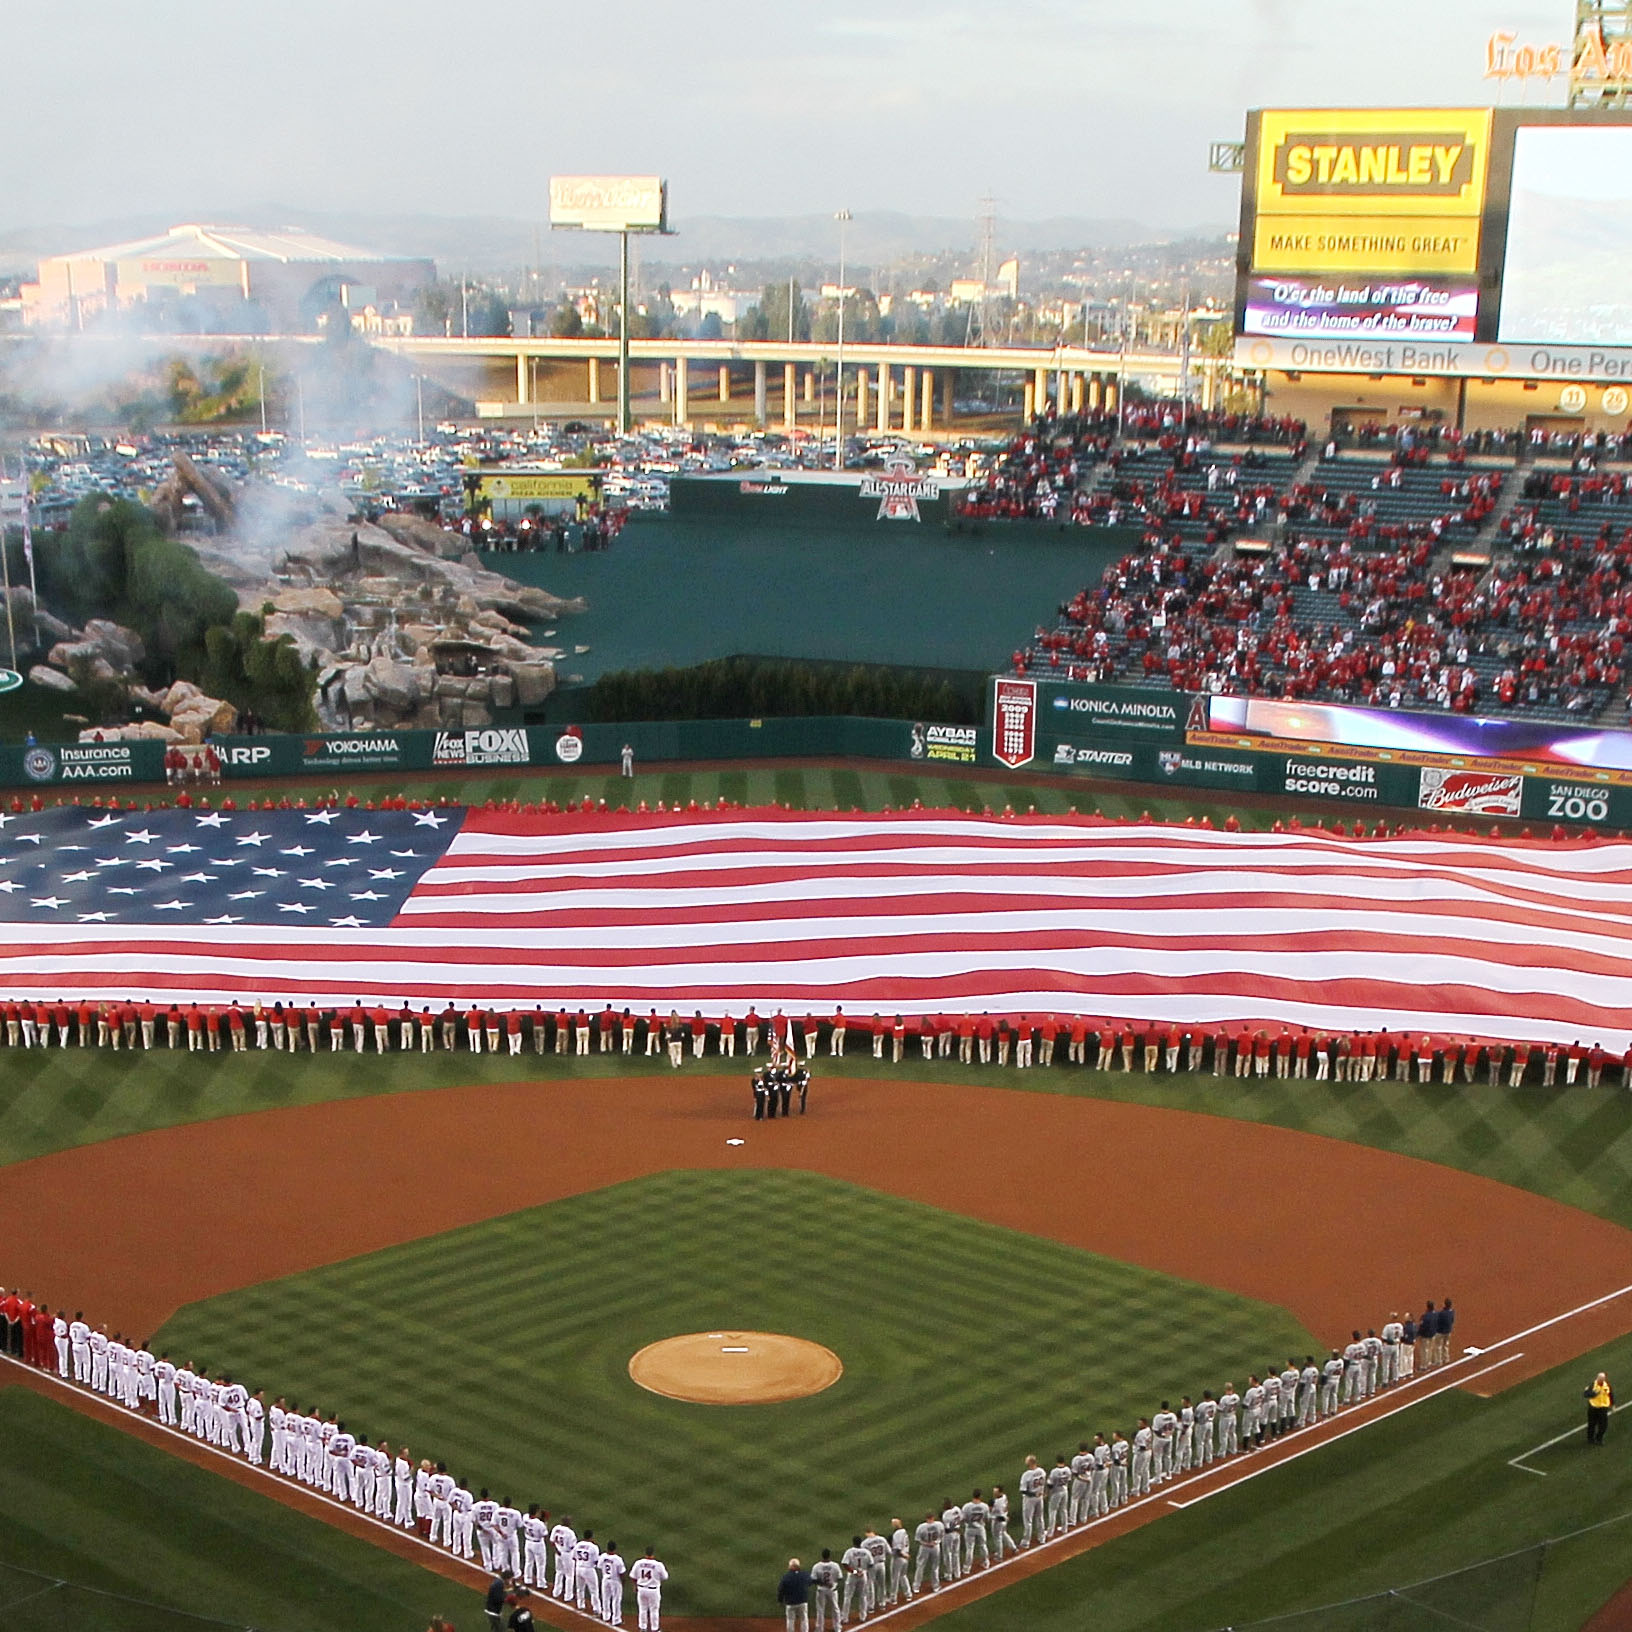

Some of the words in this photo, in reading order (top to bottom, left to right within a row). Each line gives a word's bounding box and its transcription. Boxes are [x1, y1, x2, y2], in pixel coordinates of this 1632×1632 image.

[1483, 32, 1561, 79] Los
[1286, 145, 1462, 184] STANLEY
[1271, 236, 1310, 251] MAKE
[1317, 236, 1406, 252] SOMETHING
[1412, 237, 1460, 253] GREAT
[1310, 285, 1333, 303] the
[1336, 286, 1368, 303] land
[1371, 287, 1389, 304] of
[1391, 287, 1416, 304] the
[1418, 288, 1449, 305] free
[1261, 312, 1288, 328] and
[1293, 311, 1317, 328] the
[1320, 313, 1359, 329] home
[1362, 314, 1381, 331] of
[1382, 314, 1407, 330] the
[1291, 344, 1394, 369] OneWest
[1401, 345, 1459, 371] Bank
[1531, 350, 1584, 376] One
[1071, 699, 1120, 715] KONICA
[1121, 701, 1176, 719] MINOLTA
[464, 729, 516, 753] FOX
[927, 726, 977, 740] AYBAR
[325, 739, 399, 755] YOKOHAMA
[442, 738, 465, 749] FOX
[61, 748, 131, 760] Insurance
[437, 749, 465, 759] NEWS
[927, 750, 960, 761] APRIL
[1077, 749, 1133, 765] STARTER
[62, 764, 132, 779] AAA.com
[1181, 759, 1202, 770] MLB
[1204, 762, 1254, 775] NETWORK
[1286, 759, 1376, 783] freecredit
[1285, 778, 1378, 799] score.com
[1425, 776, 1520, 808] Budweiser
[1551, 785, 1574, 796] SAN
[1576, 786, 1610, 800] DIEGO
[1548, 797, 1609, 821] ZOO
